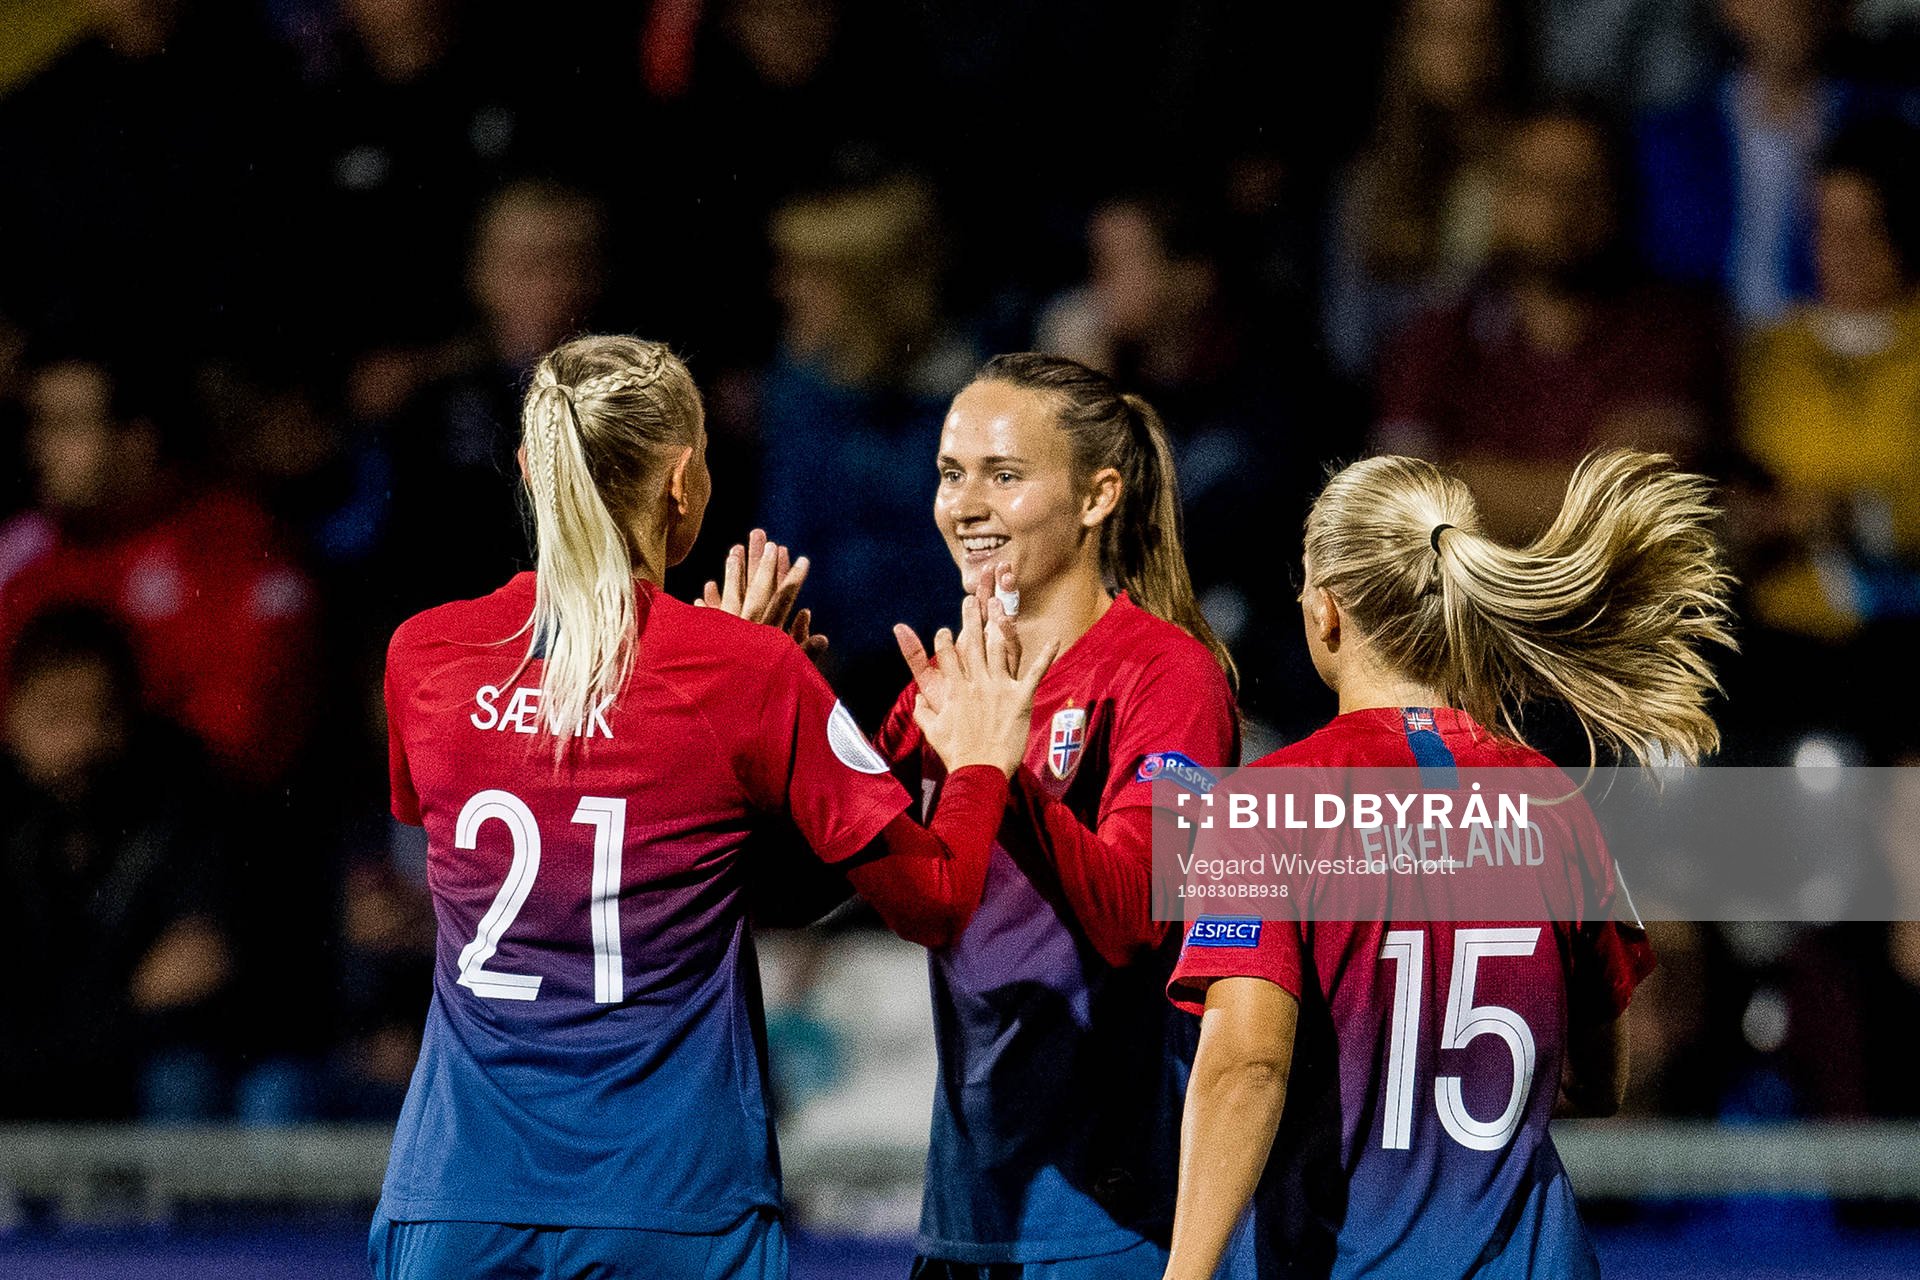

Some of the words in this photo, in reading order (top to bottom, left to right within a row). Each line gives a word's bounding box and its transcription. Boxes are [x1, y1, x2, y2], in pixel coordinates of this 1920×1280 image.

[1166, 758, 1215, 792] RESPEC
[1360, 821, 1545, 873] EIKELAND
[455, 789, 627, 1004] 21
[1190, 922, 1260, 939] ESPECT
[1379, 927, 1542, 1151] 15
